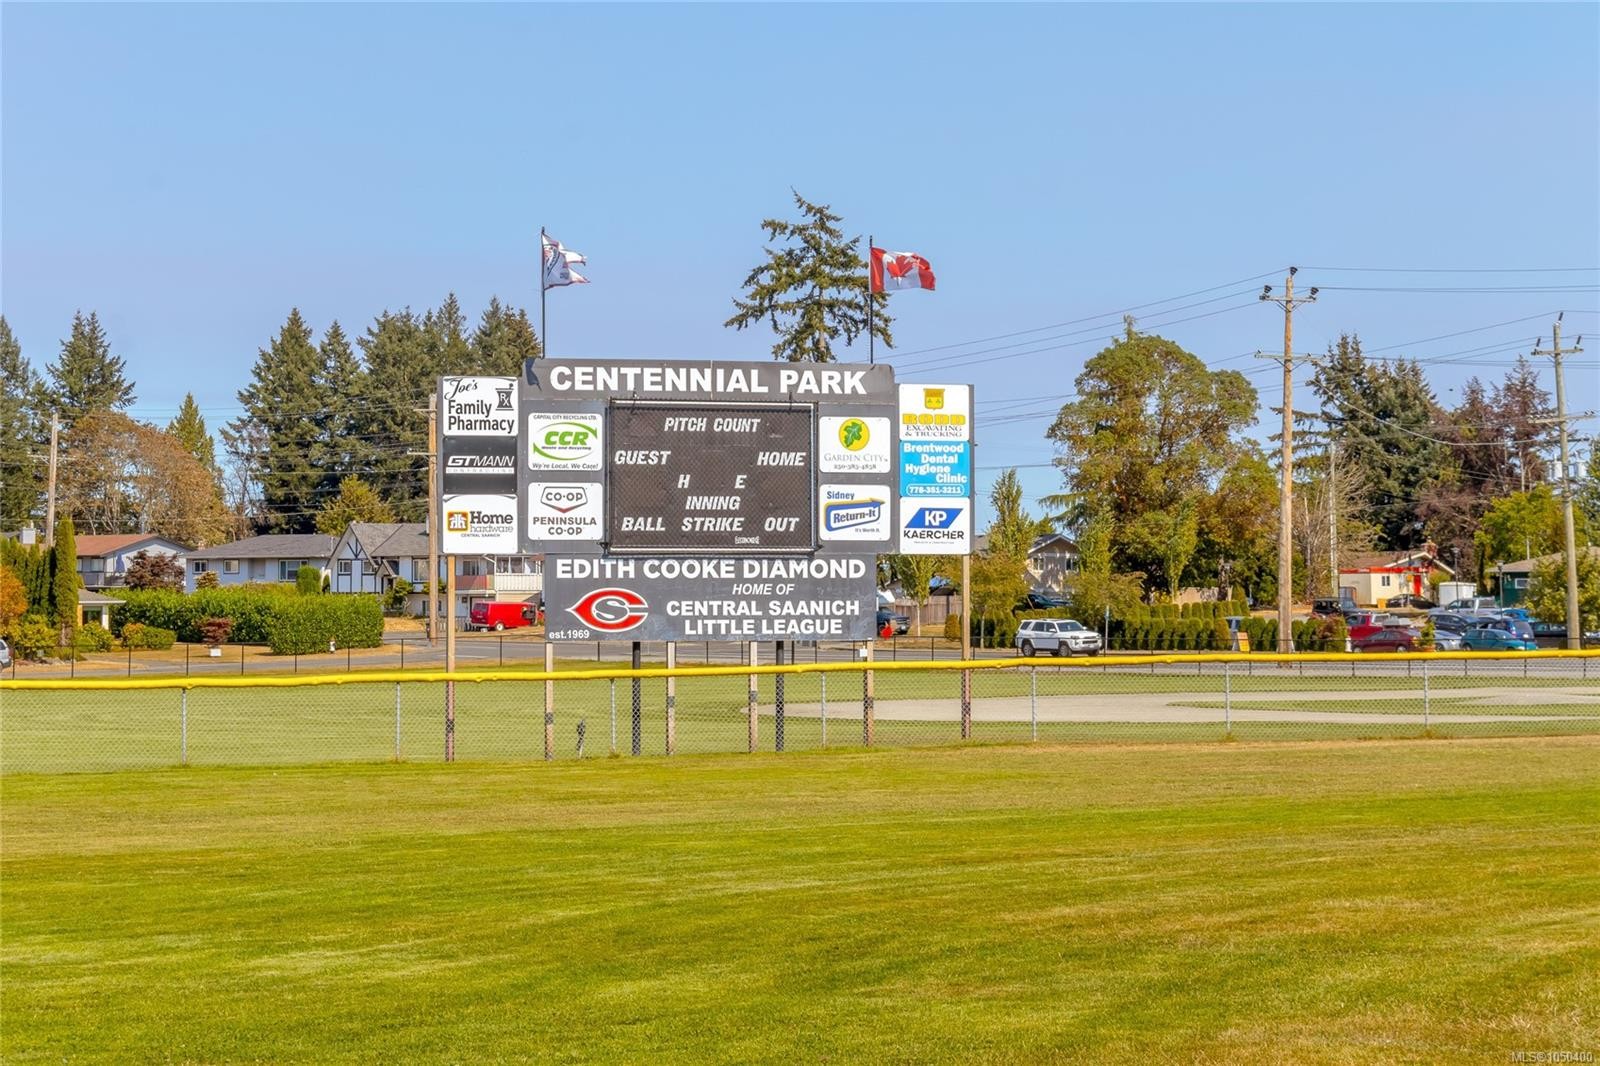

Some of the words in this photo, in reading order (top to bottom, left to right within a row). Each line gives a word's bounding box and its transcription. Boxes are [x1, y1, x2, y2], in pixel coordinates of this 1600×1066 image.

[549, 366, 768, 393] CENTENNIAL
[779, 370, 867, 395] PARK
[444, 379, 478, 400] Joe's
[448, 400, 492, 418] Family
[448, 415, 515, 434] Pharmacy
[664, 417, 707, 432] PITCH
[713, 418, 761, 433] COUNT
[544, 430, 589, 446] CCR
[903, 442, 964, 453] Brentwood
[614, 450, 671, 465] GUEST
[757, 452, 806, 467] HOME
[824, 453, 860, 462] GARDEN
[921, 453, 958, 464] Dental
[905, 463, 951, 475] Hygiene
[677, 474, 691, 489] H
[734, 475, 747, 489] E
[935, 472, 968, 483] Clinic
[685, 495, 741, 510] INNING
[826, 490, 855, 500] Sidney
[469, 510, 514, 525] Home
[533, 517, 597, 526] PENINSULA
[833, 509, 876, 524] Return-It
[924, 510, 947, 526] KP
[470, 525, 514, 533] hardware
[621, 517, 666, 532] BALL
[681, 517, 744, 532] STRIKE
[764, 517, 799, 532] OUT
[903, 530, 965, 540] KAERCHER
[556, 558, 635, 579] EDITH
[643, 558, 735, 579] COOKE
[743, 558, 866, 579] DIAMOND
[732, 583, 773, 595] HOME
[776, 583, 795, 595] OF
[666, 600, 762, 616] CENTRAL
[769, 600, 860, 616] SAANICH
[685, 619, 755, 635] LITTLE
[762, 619, 842, 635] LEAGUE
